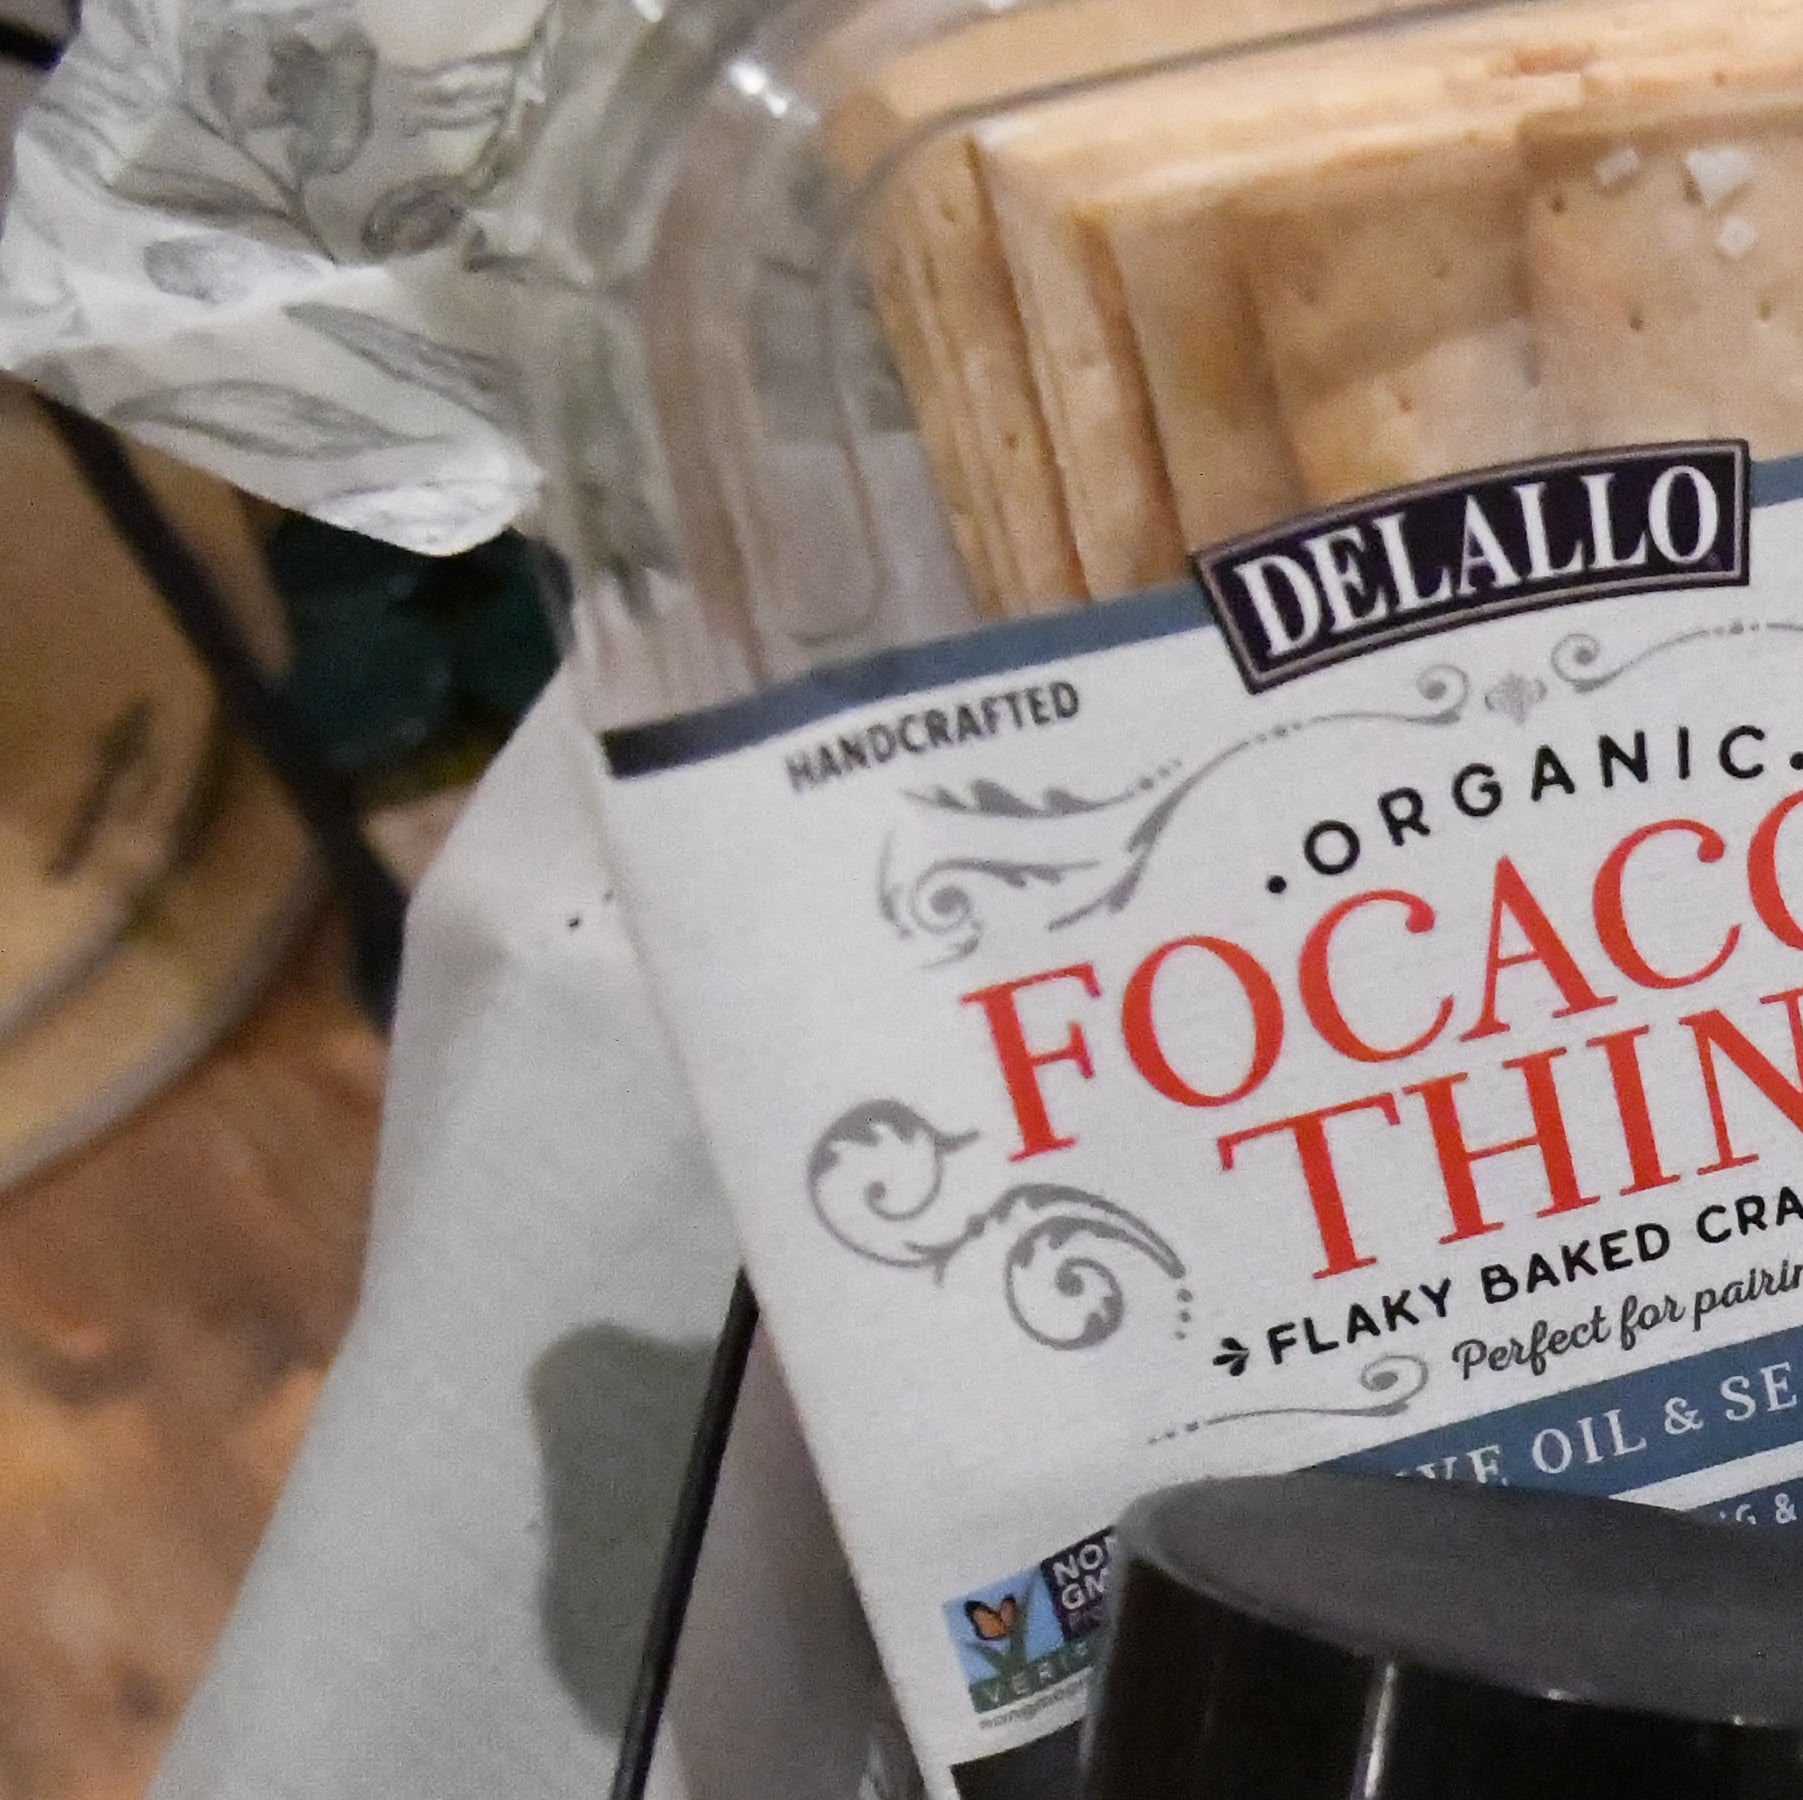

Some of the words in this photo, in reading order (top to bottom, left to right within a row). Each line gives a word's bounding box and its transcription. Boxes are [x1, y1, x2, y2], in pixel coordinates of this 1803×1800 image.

[1232, 463, 1722, 662] DELALLO
[786, 680, 1081, 793] HANDCRAFTED
[1266, 1280, 1452, 1366] FLAKY
[1482, 1224, 1672, 1306] BAKED
[1451, 1306, 1611, 1381] Perfect
[1619, 1286, 1687, 1351] for
[1531, 1408, 1647, 1475] OIL
[1664, 1396, 1706, 1436] &
